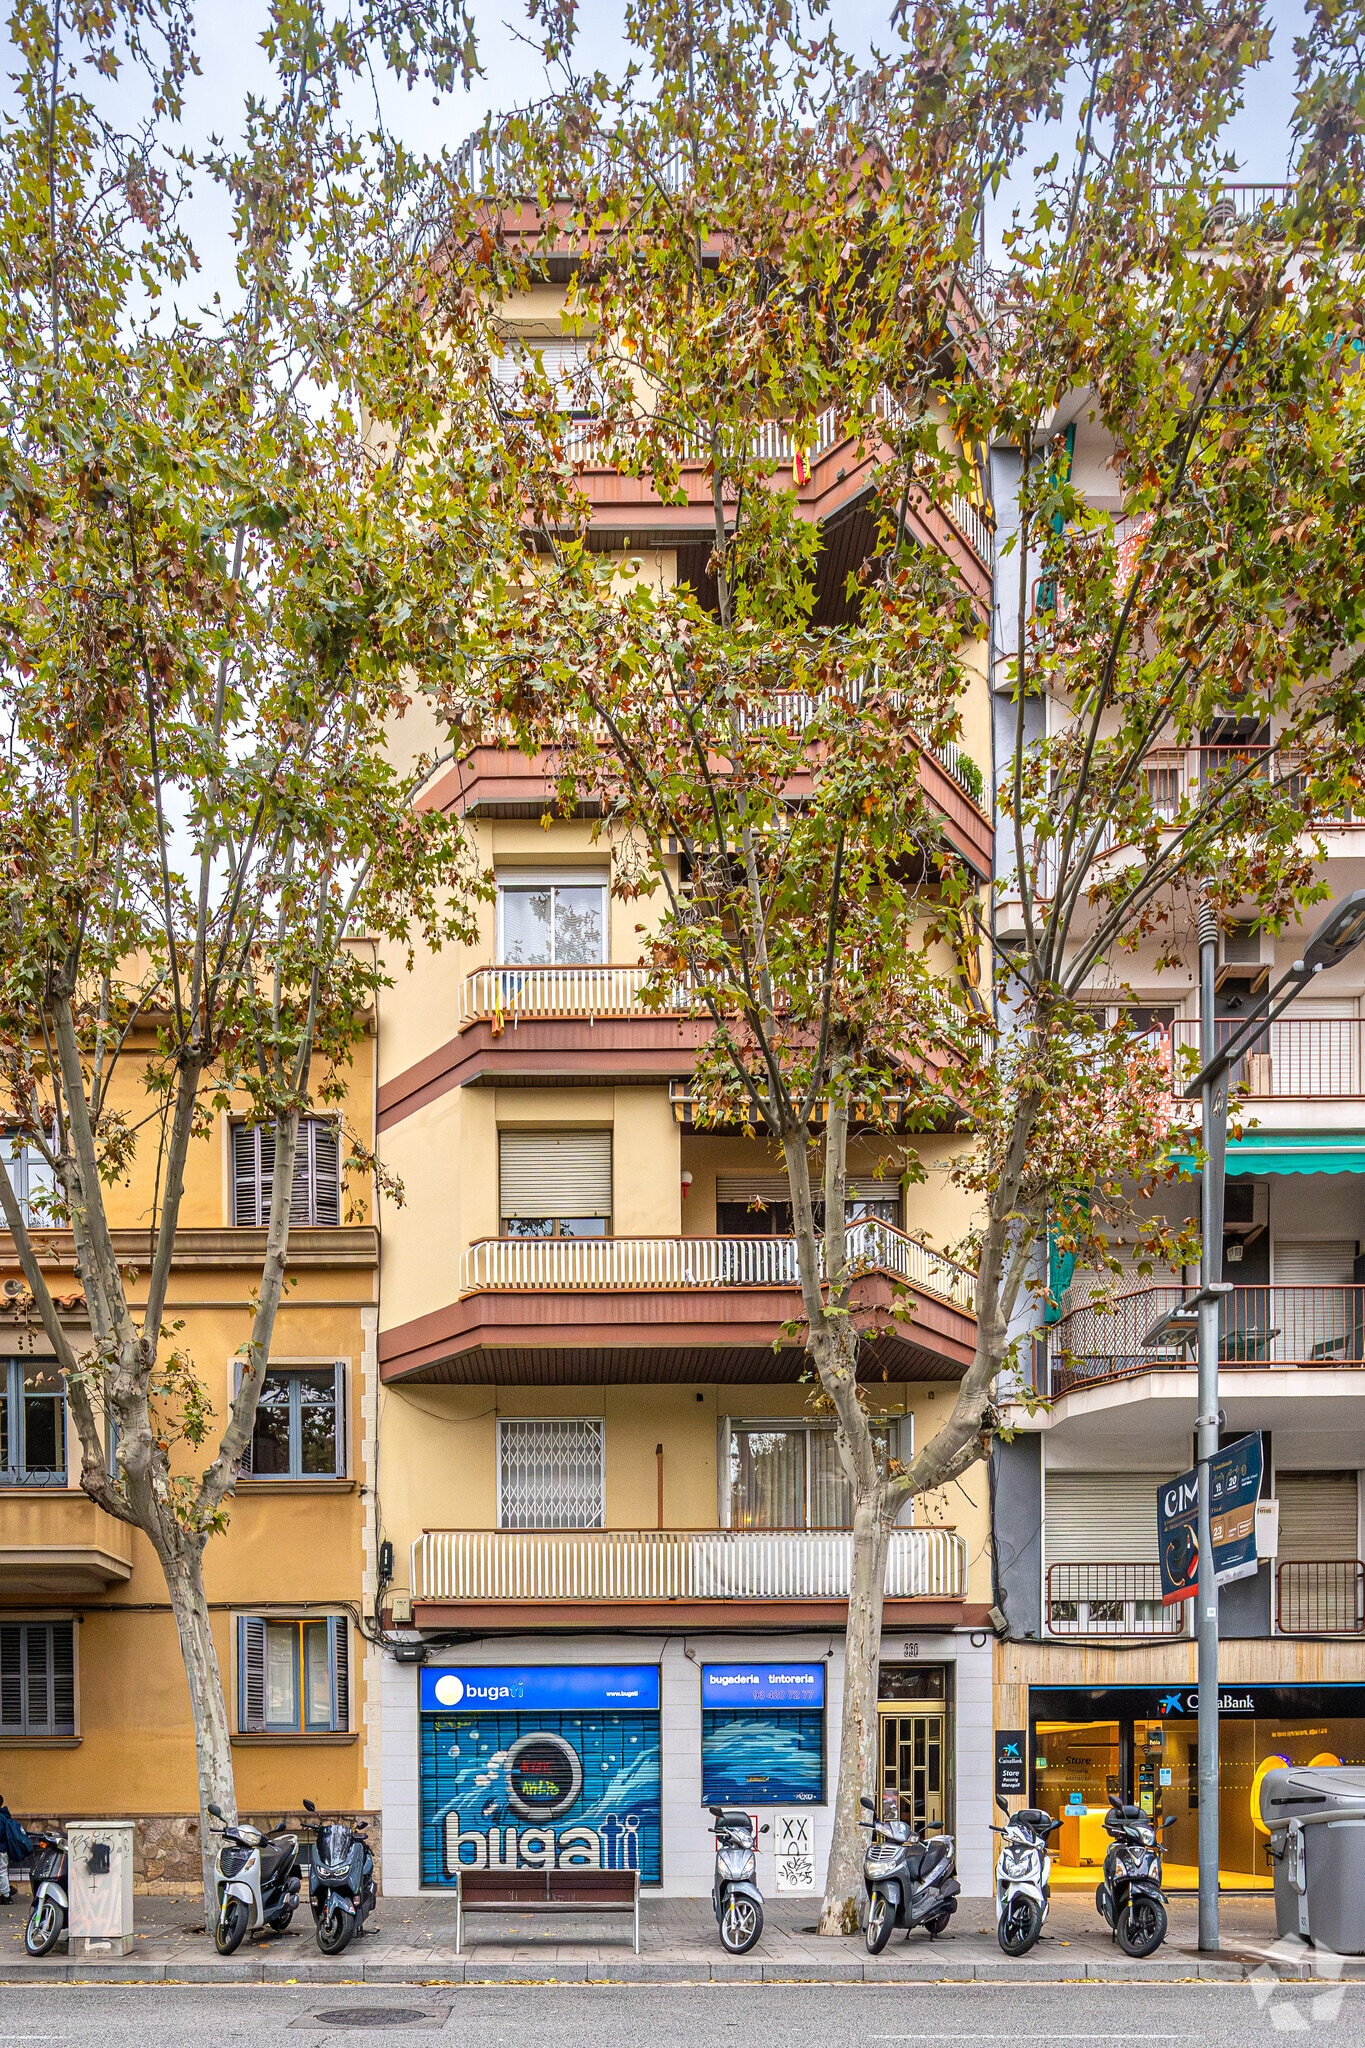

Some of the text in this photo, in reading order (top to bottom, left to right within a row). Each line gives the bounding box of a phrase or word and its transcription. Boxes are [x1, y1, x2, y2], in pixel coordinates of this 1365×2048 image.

[1229, 1475, 1237, 1486] 20
[1213, 1526, 1223, 1536] 23
[709, 1674, 815, 1686] bugaderia tintoreria
[466, 1680, 524, 1700] bugati
[801, 1689, 815, 1700] 77
[1187, 1695, 1254, 1708] CaBank
[1065, 1755, 1092, 1765] Store
[1002, 1769, 1020, 1777] Store
[444, 1810, 640, 1874] bugati
